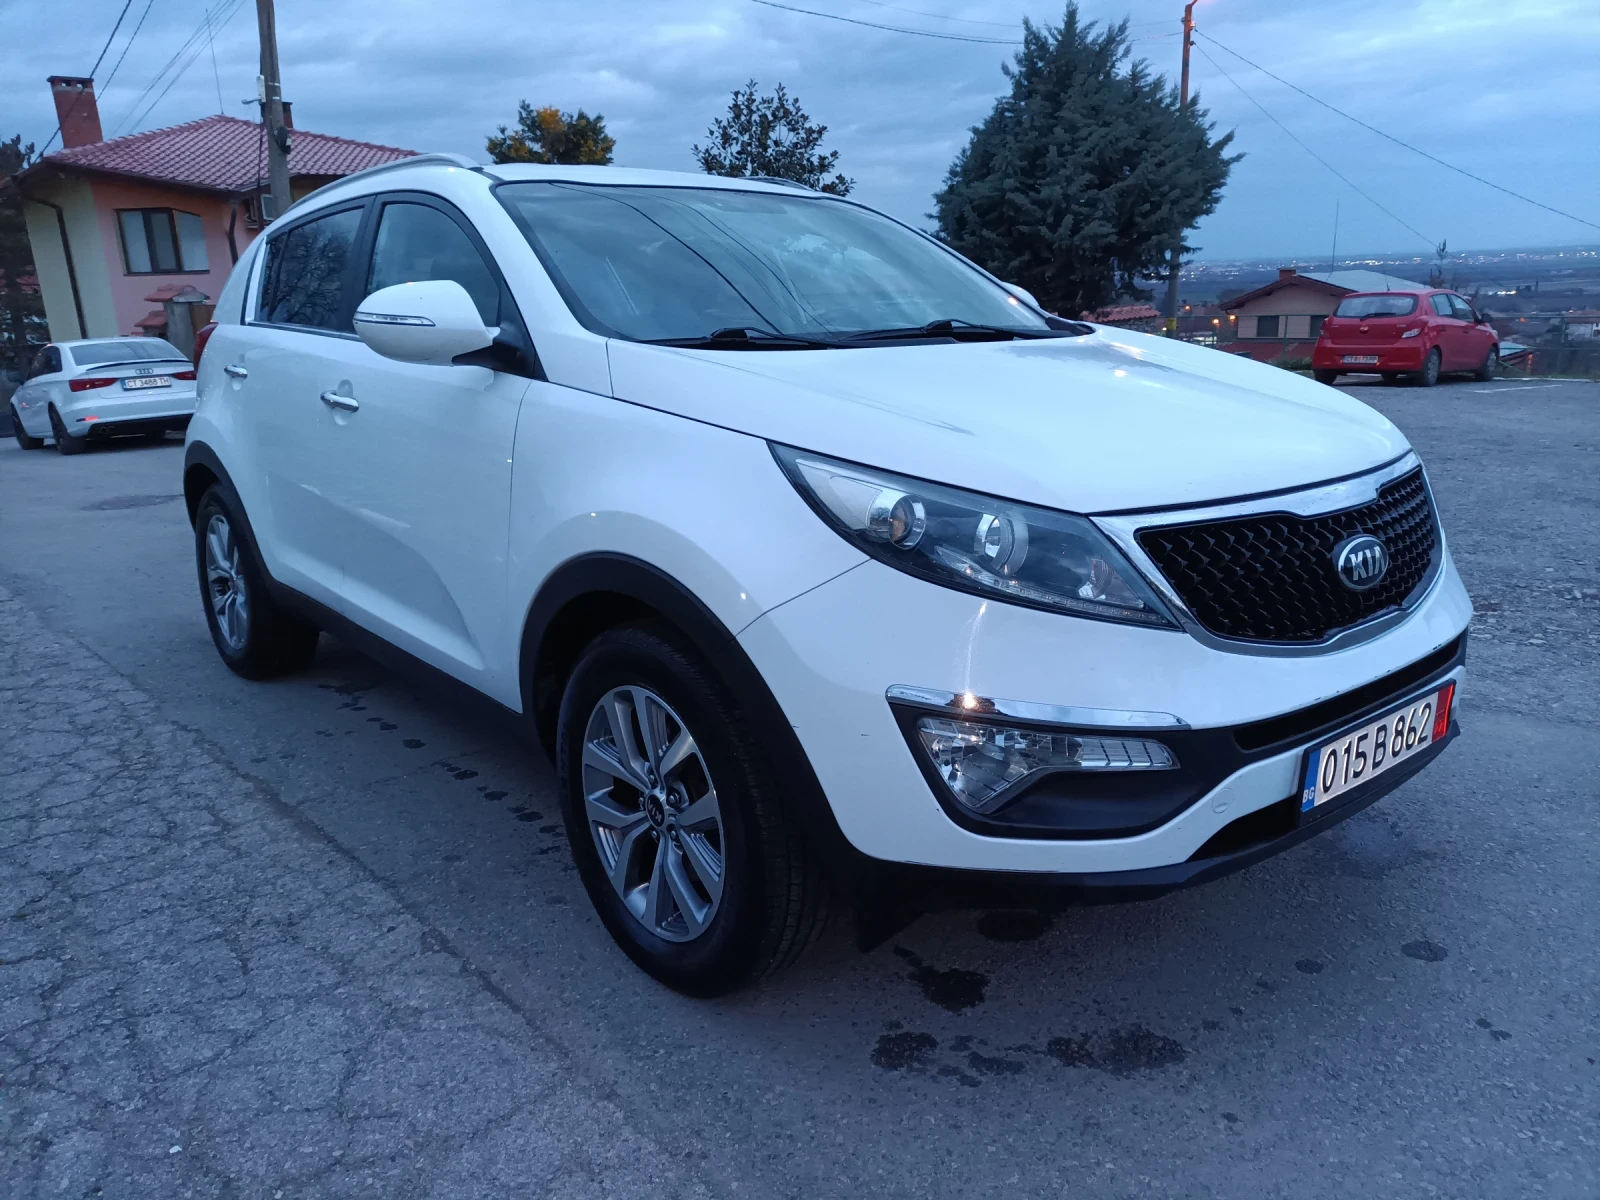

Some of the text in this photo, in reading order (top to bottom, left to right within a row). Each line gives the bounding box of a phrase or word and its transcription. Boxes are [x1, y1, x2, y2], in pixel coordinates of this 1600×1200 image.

[127, 380, 137, 388] CT
[1349, 546, 1385, 580] KIA
[1321, 702, 1432, 794] 015B862
[1302, 787, 1314, 803] BG
[647, 800, 662, 822] KIA
